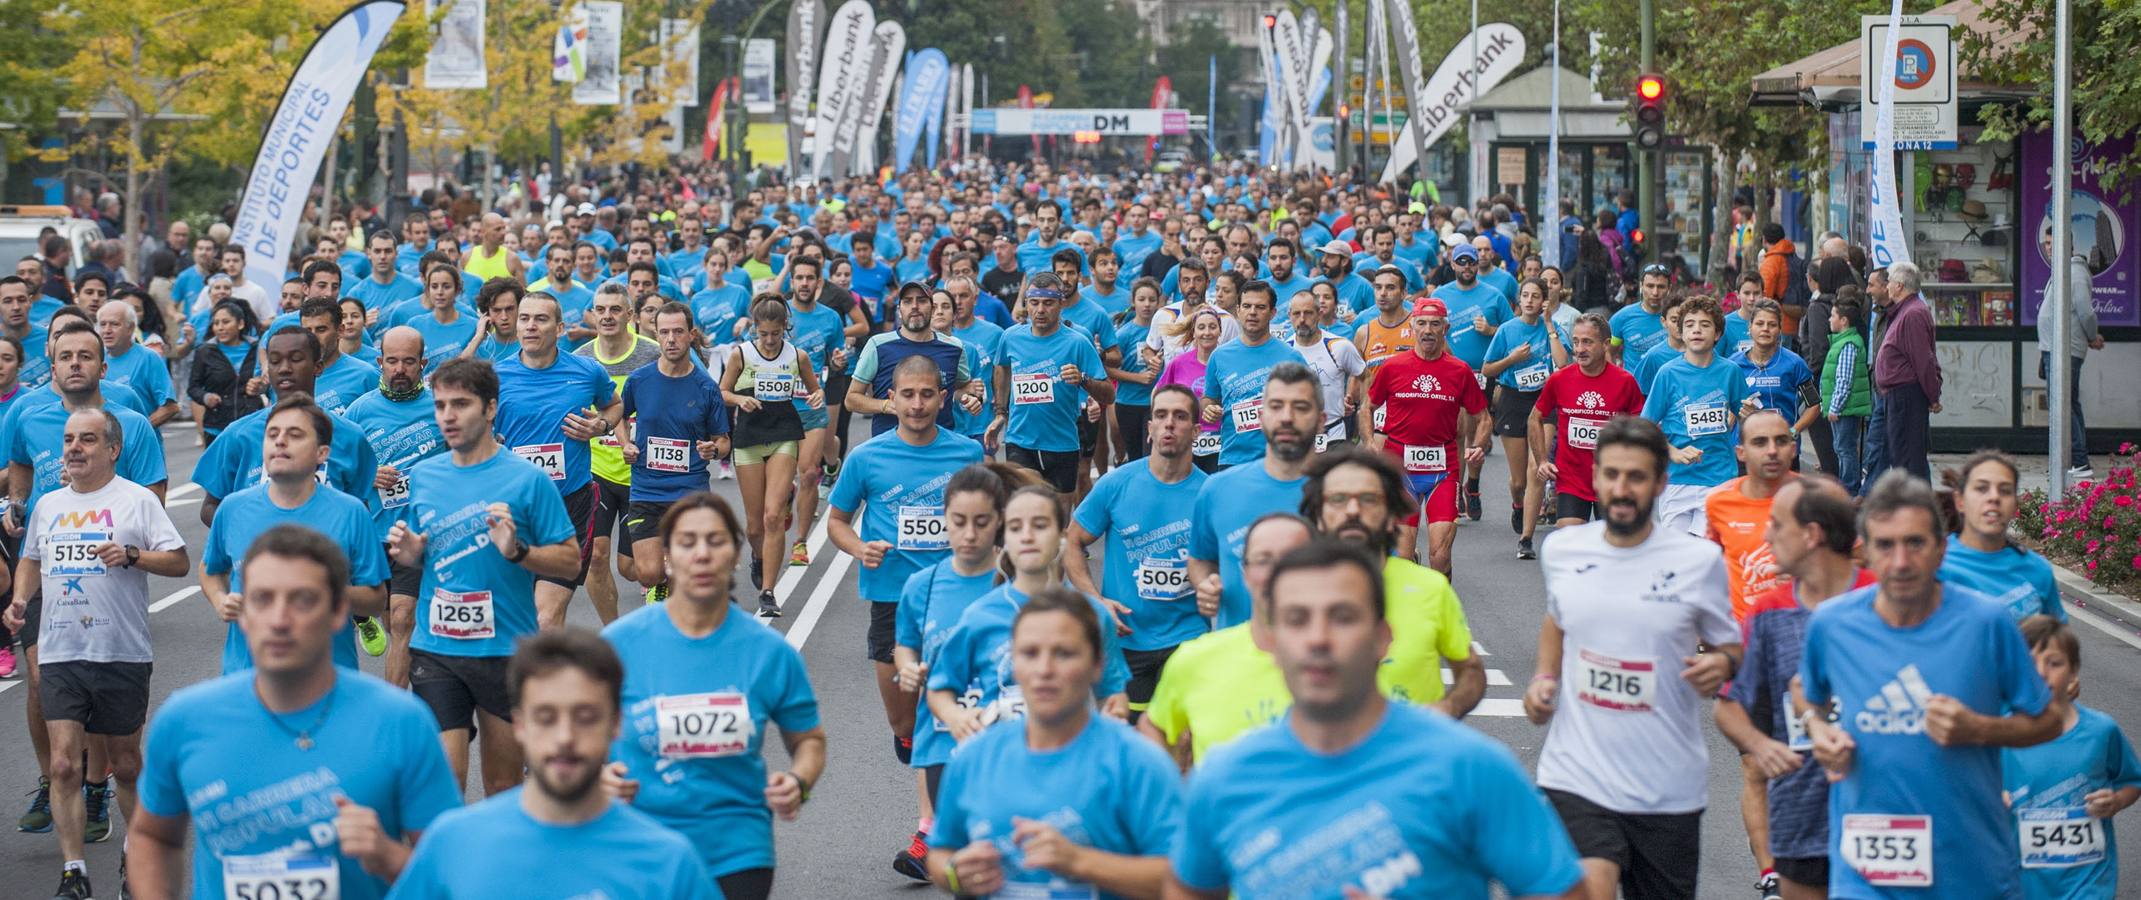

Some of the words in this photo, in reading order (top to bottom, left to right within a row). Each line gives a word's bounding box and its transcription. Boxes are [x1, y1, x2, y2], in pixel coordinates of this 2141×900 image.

[822, 10, 865, 123] Liberbank
[1094, 115, 1130, 132] DM
[1922, 141, 1932, 150] 12
[235, 163, 271, 249] NSTITUTO
[264, 80, 311, 163] MUNICIPAL
[254, 222, 277, 260] DE
[267, 88, 330, 220] DEPORTES
[758, 381, 791, 392] 5508
[1412, 375, 1441, 391] FRIGORSA
[1521, 372, 1546, 385] 5163
[1017, 382, 1048, 394] 1200
[1576, 391, 1606, 407] FRIGORSA
[1690, 411, 1723, 424] 5483
[381, 421, 428, 445] CARRERA
[1573, 427, 1598, 440] 106
[375, 429, 432, 462] POPULAR
[419, 440, 436, 455] DM
[654, 447, 684, 461] 1138
[1411, 451, 1440, 461] 1061
[904, 520, 948, 535] 550
[1134, 519, 1192, 546] CARRERA
[475, 533, 491, 549] D
[437, 604, 484, 623] 1263
[1589, 669, 1641, 695] 1216
[671, 712, 737, 736] 1072
[1856, 709, 1926, 735] adid
[309, 822, 337, 848] D
[2032, 822, 2095, 848] 5431
[1855, 836, 1917, 860] 1353
[235, 879, 328, 900] 5032
